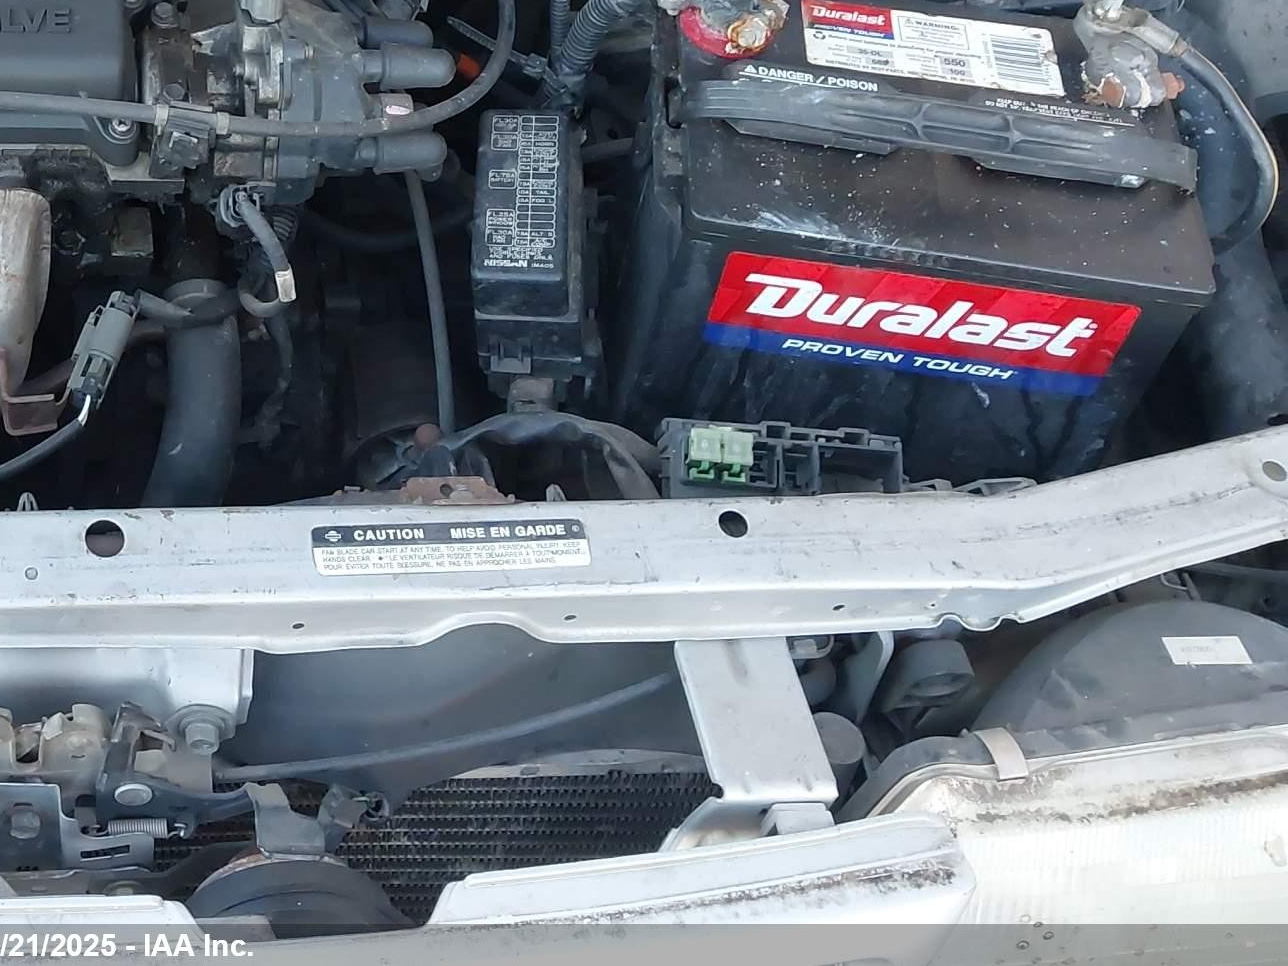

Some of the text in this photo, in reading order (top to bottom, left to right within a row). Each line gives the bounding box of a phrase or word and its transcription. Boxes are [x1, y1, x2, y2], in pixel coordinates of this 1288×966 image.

[810, 5, 886, 26] Duralast
[813, 24, 851, 33] PROVEN
[944, 57, 966, 68] 550
[758, 66, 814, 83] DANGER
[827, 76, 878, 92] POISON
[484, 259, 528, 268] NISSAN
[744, 272, 1099, 358] Duralast
[781, 337, 1013, 380] PROVEN TOUGH
[353, 528, 425, 541] CAUTION
[450, 524, 567, 539] MISE EN GARDE
[399, 553, 445, 561] VENTILATEUR
